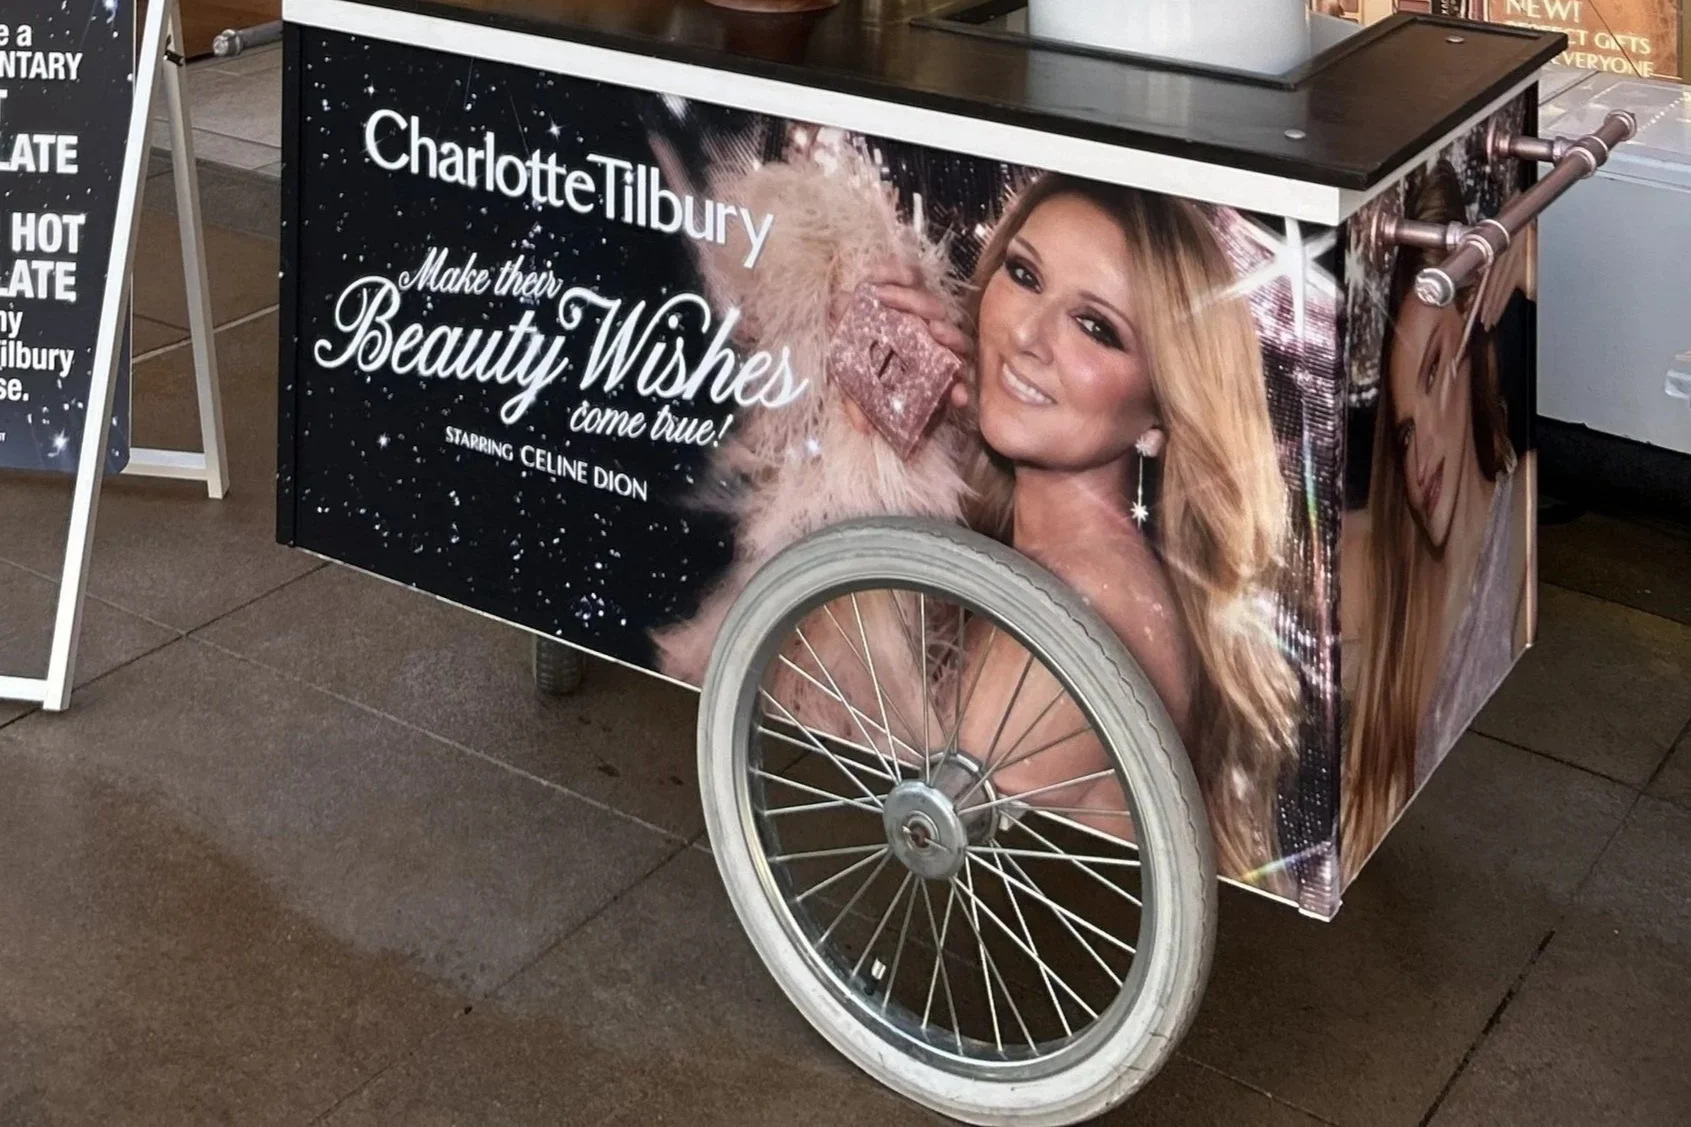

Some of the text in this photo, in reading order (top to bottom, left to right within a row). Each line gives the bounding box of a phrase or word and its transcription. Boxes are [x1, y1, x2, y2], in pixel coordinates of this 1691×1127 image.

[16, 24, 33, 47] a
[1594, 32, 1652, 55] GIFTS
[11, 212, 87, 254] HOT
[399, 246, 563, 299] Make their
[0, 339, 75, 378] ilbury
[314, 275, 810, 425] Beauty Wishes
[570, 400, 734, 448] come true!
[445, 425, 649, 502] STARRING CELINE DION
